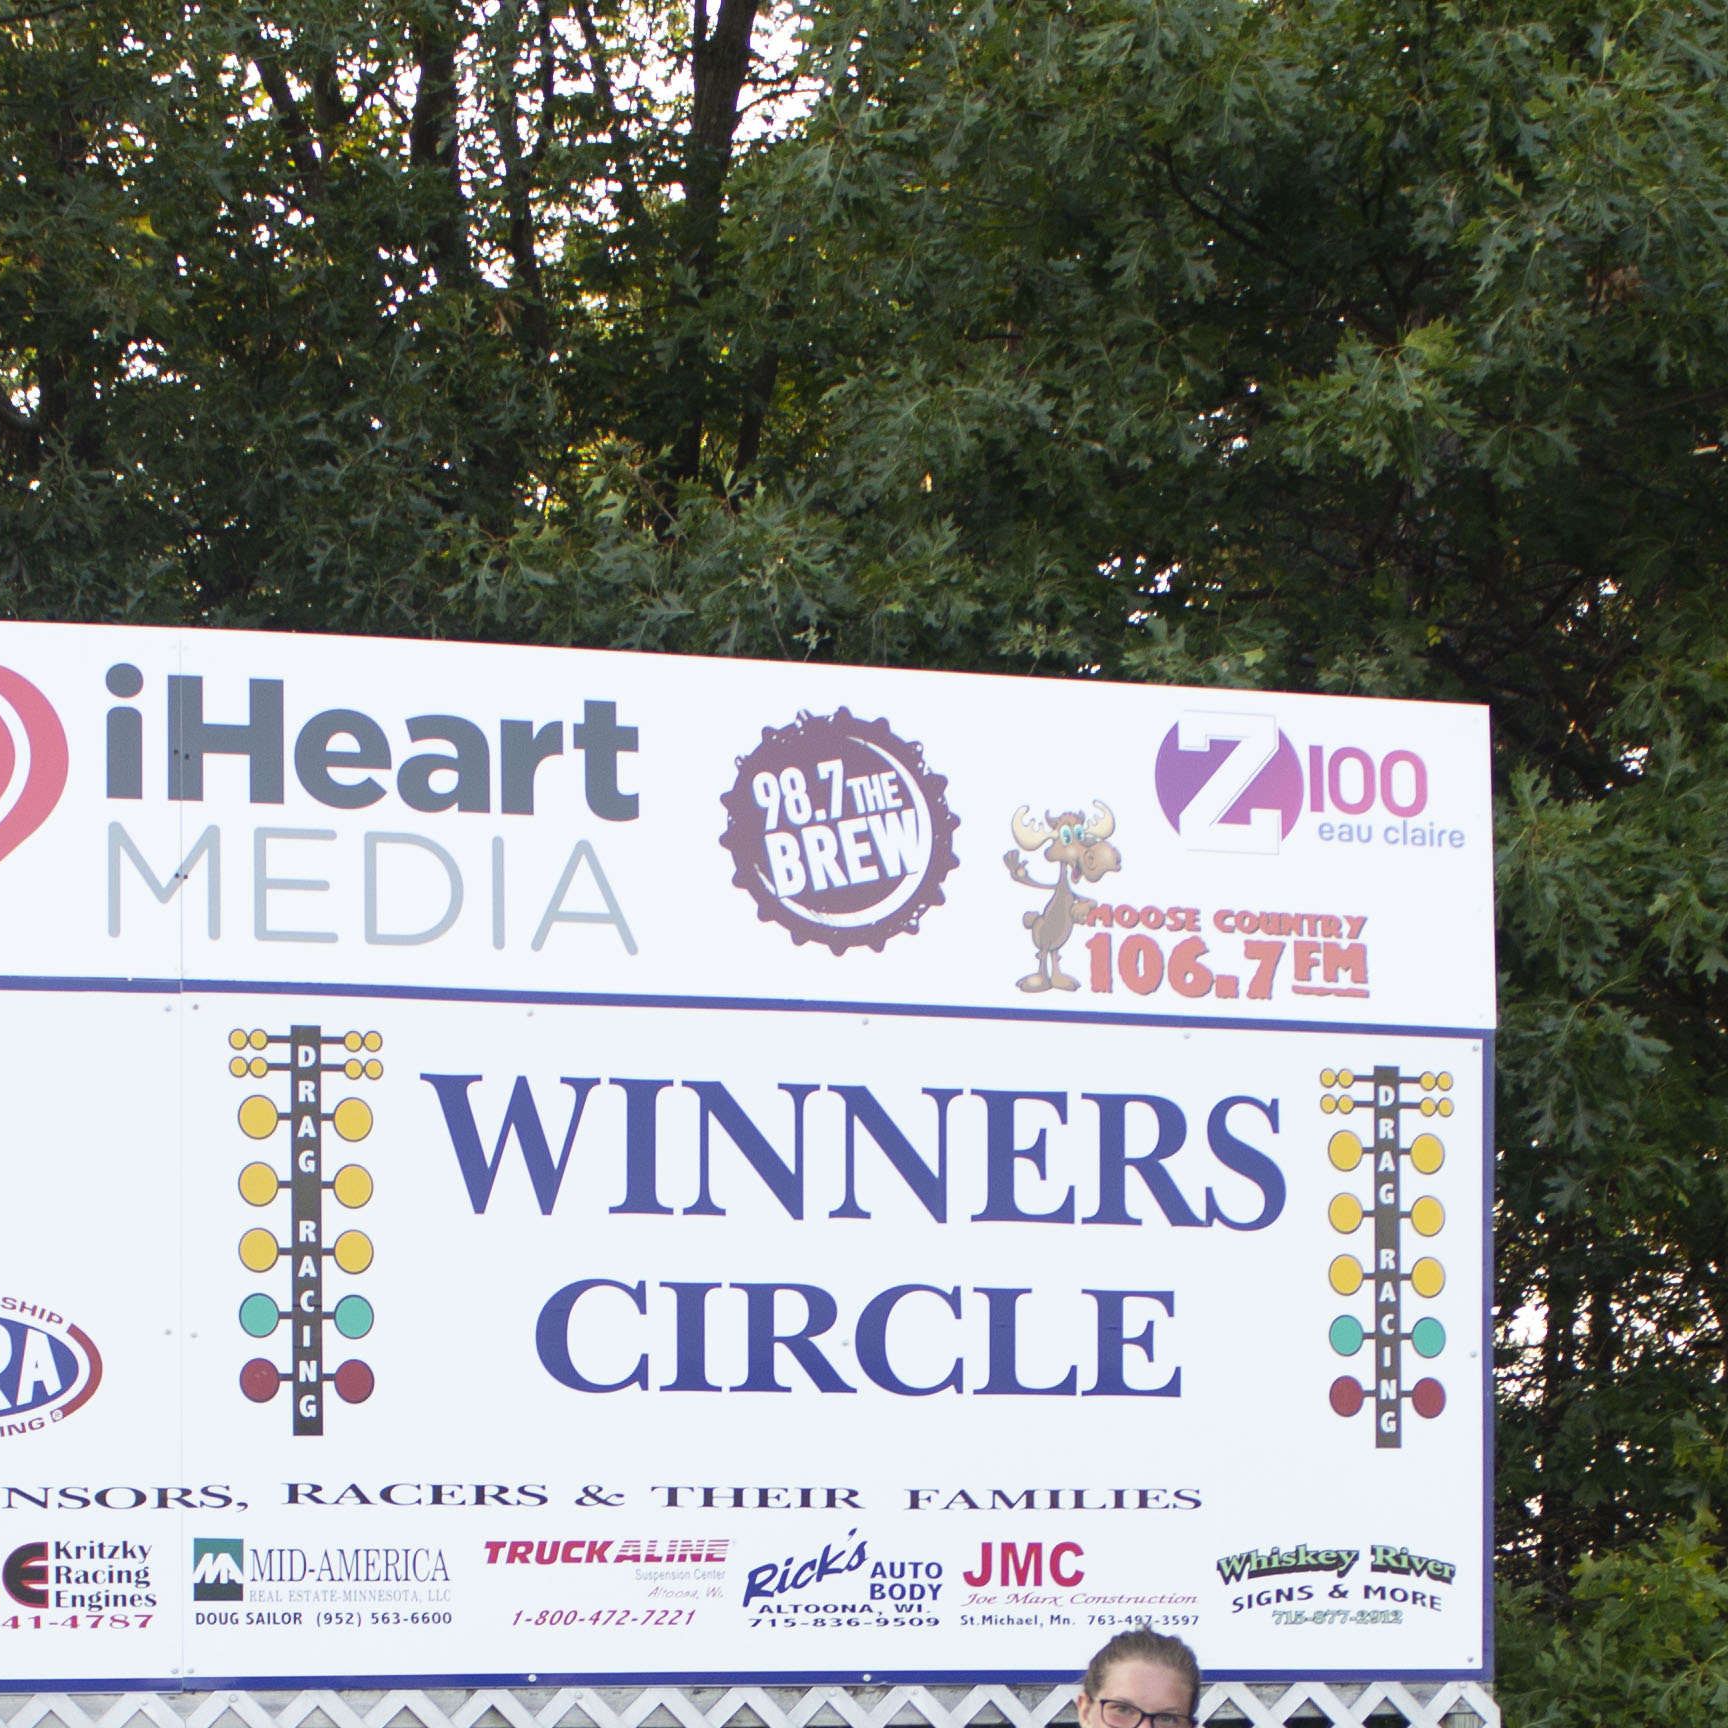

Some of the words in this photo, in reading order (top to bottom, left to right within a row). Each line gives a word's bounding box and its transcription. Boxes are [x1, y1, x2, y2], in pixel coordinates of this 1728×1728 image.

[105, 662, 639, 822] iHeart
[752, 758, 844, 831] 98.7
[846, 770, 903, 815] THE
[1318, 822, 1373, 844] eau
[1383, 820, 1466, 849] claire
[765, 808, 920, 898] BREW
[108, 821, 639, 956] MEDIA
[1086, 904, 1201, 932] MOOSE
[1213, 909, 1368, 939] COUNTRY
[1085, 932, 1286, 1000] 106.7
[1293, 940, 1369, 984] FM
[297, 1045, 317, 1174] DRAG
[419, 1072, 1287, 1231] WINNERS
[1378, 1085, 1396, 1205] DRAG
[298, 1220, 318, 1419] RACING
[535, 1278, 1182, 1397] CIRCLE
[1379, 1248, 1398, 1434] RACING
[282, 1482, 549, 1507] RACERS
[575, 1483, 625, 1507] &
[652, 1485, 867, 1510] THEIR
[905, 1487, 1205, 1510] FAMILIES
[54, 1541, 152, 1564] Kritzky
[249, 1548, 451, 1582] MID-AMERICA
[962, 1541, 1085, 1587] JMC
[1217, 1543, 1359, 1585] Whiskey
[1371, 1545, 1456, 1585] River
[54, 1565, 151, 1588] Racing
[635, 1568, 690, 1581] Suspension
[694, 1568, 726, 1580] Center
[743, 1528, 870, 1607] Rick's
[870, 1561, 943, 1579] AUTO
[55, 1590, 157, 1612] Engines
[249, 1590, 282, 1602] REAL
[428, 1589, 451, 1601] LLC
[870, 1583, 943, 1600] BODY
[960, 1593, 997, 1607] Joe
[1005, 1592, 1063, 1607] Marx
[1070, 1592, 1198, 1605] Construction
[1232, 1585, 1314, 1613] SIGNS
[1328, 1584, 1349, 1599] &
[1363, 1585, 1443, 1612] MORE
[195, 1612, 239, 1625] DOUG
[246, 1612, 303, 1625] SAILOR
[317, 1612, 362, 1627] (952)
[371, 1612, 452, 1625] 563-6600
[512, 1609, 696, 1626] 1-800-472-7221
[749, 1618, 940, 1627] 715-836-9509
[758, 1604, 883, 1615] ALTOONA,
[894, 1604, 931, 1613] WI.
[1050, 1616, 1076, 1625] Mn.
[1088, 1614, 1200, 1626] 763-497-3597
[1272, 1609, 1404, 1625] 715-877-2912
